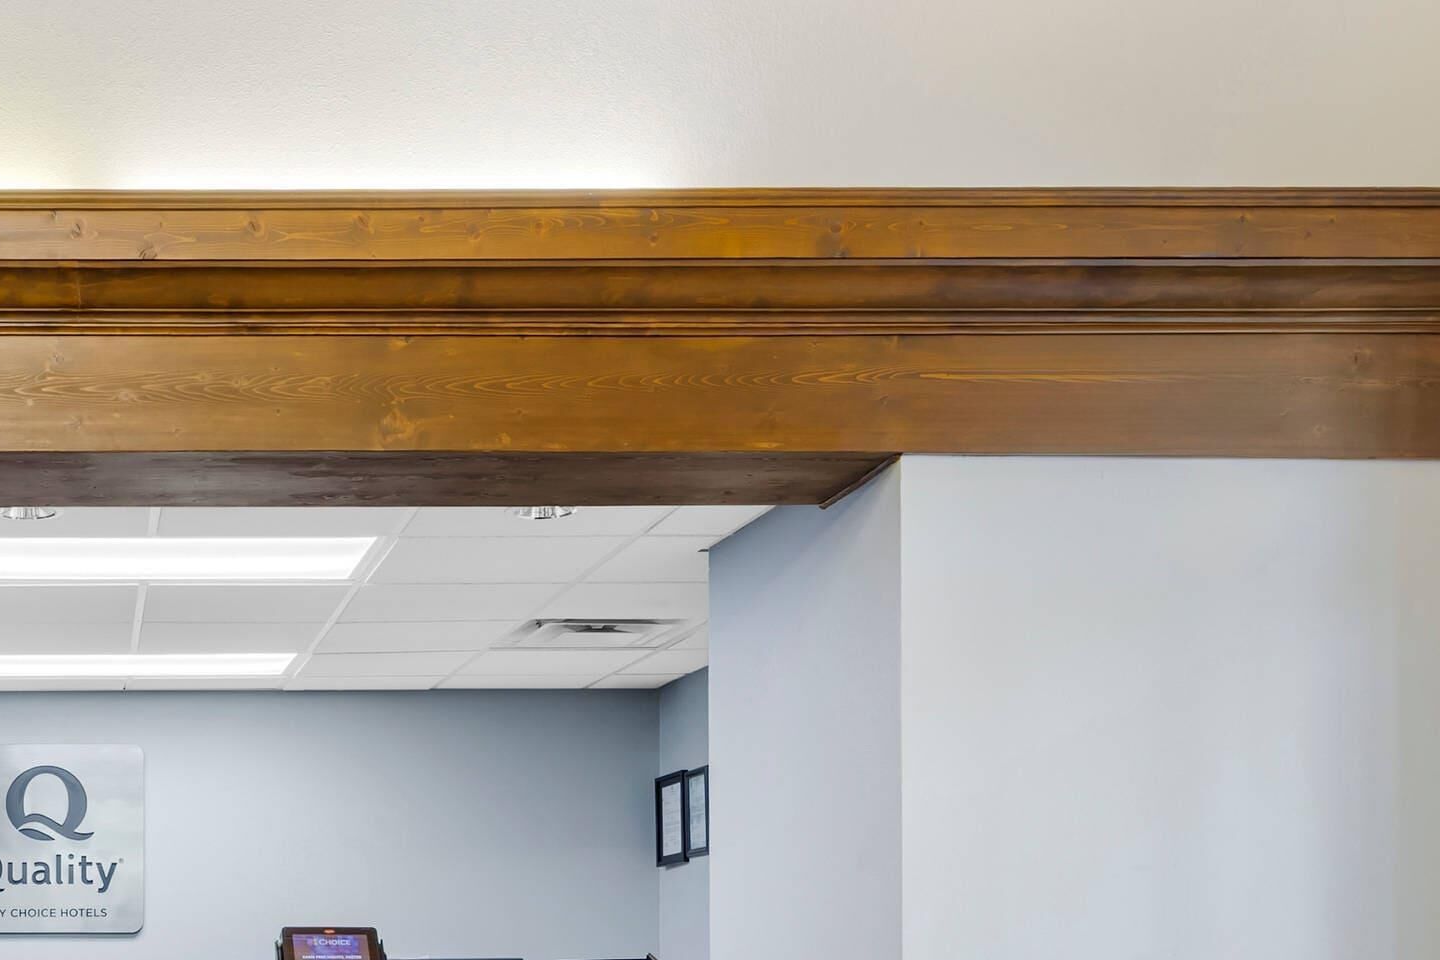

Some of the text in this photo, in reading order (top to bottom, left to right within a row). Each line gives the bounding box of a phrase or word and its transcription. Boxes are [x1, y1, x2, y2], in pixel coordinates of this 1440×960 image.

[6, 765, 95, 841] Q
[10, 908, 57, 918] CHOICE
[60, 908, 108, 918] HOTELS
